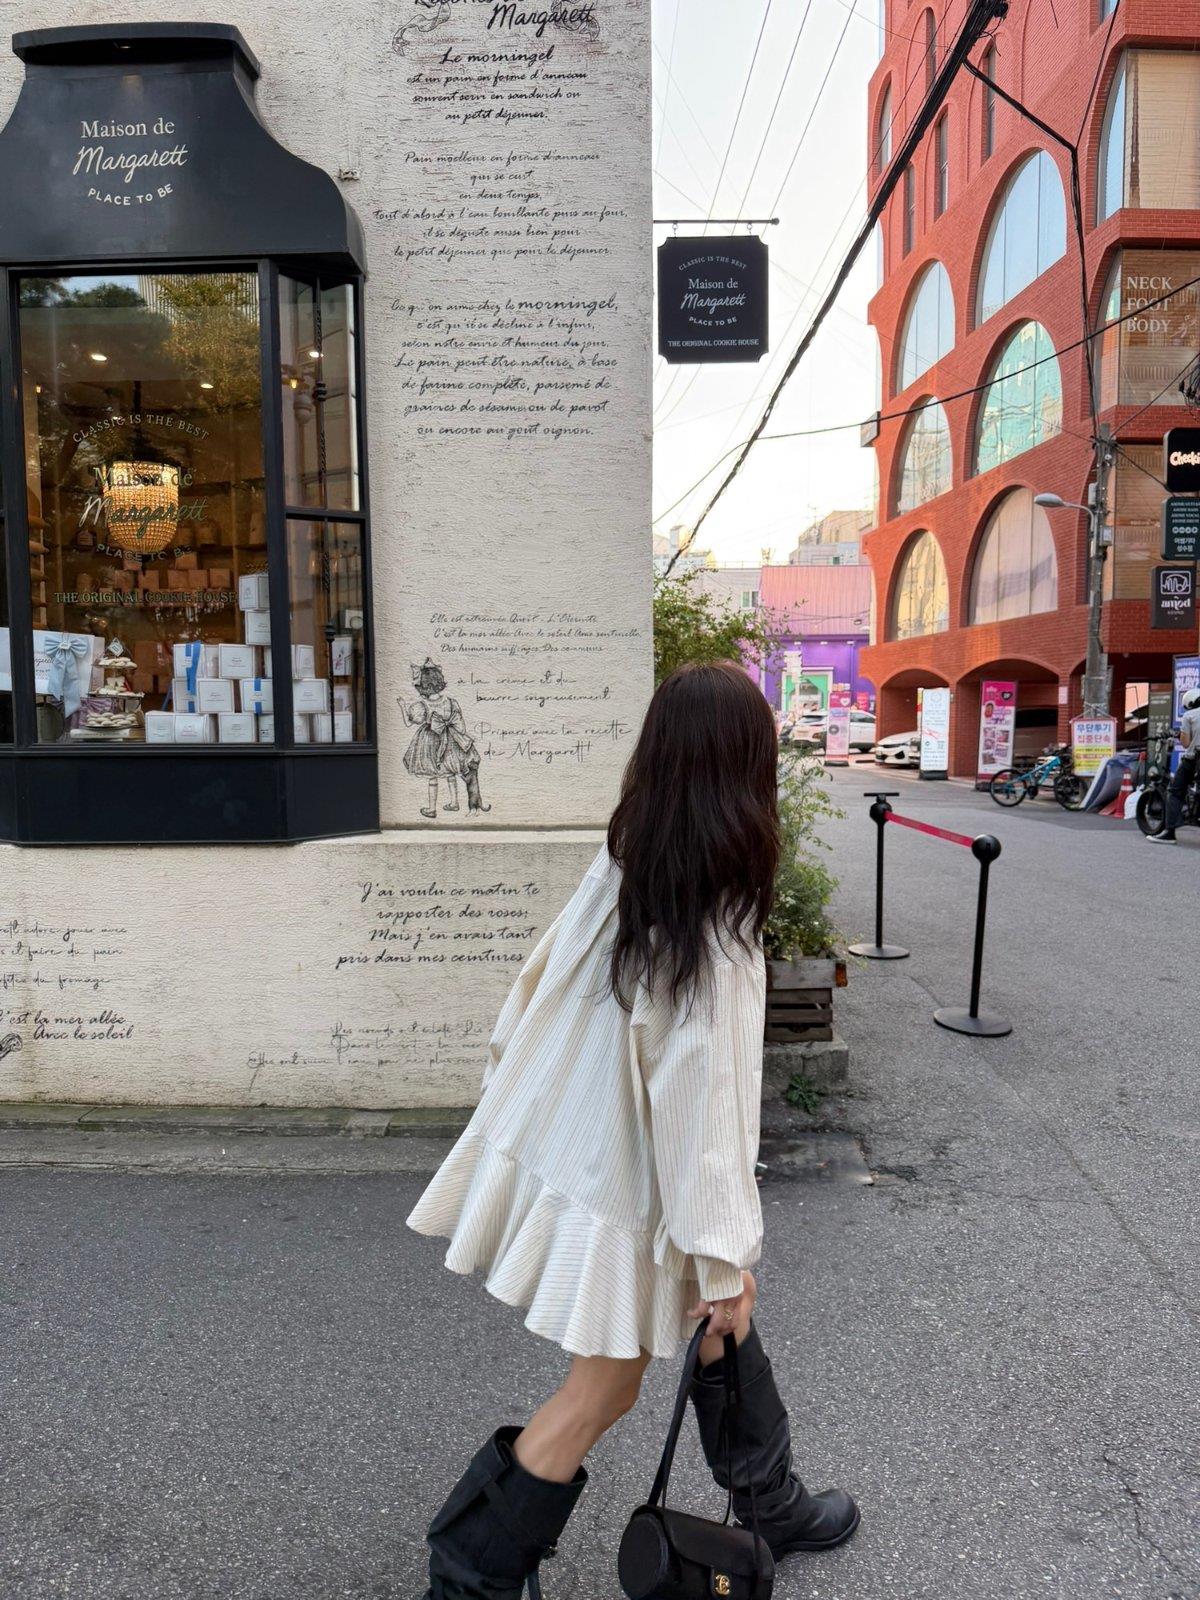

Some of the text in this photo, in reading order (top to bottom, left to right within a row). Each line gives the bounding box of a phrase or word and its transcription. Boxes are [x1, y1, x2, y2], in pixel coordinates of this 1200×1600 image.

[487, 4, 594, 37] Margarett
[439, 45, 555, 66] Le morningel
[493, 70, 526, 87] forme
[413, 91, 459, 102] souvent
[508, 88, 562, 99] sandwich
[463, 109, 494, 124] petit
[81, 118, 175, 138] Maison de
[73, 144, 188, 183] Margarett
[405, 151, 432, 163] Pain
[88, 183, 173, 205] PLACE TO BE
[406, 246, 436, 261] petit
[679, 256, 706, 271] CLASSIC
[731, 259, 747, 269] BEST
[688, 278, 738, 289] Maison de
[1127, 276, 1173, 289] NECK
[680, 293, 746, 314] Margarett
[1127, 298, 1172, 311] FOOT
[689, 316, 712, 326] PLACE
[1127, 319, 1172, 332] BODY
[416, 360, 450, 372] pain
[419, 376, 464, 396] farine
[403, 401, 456, 417] graines
[460, 399, 476, 412] de
[550, 399, 565, 412] de
[568, 400, 610, 417] pavot
[72, 413, 209, 443] CLASSIC IS THE BEST
[438, 426, 482, 435] encore
[93, 466, 193, 487] Maison de
[78, 495, 208, 539] Margarett
[97, 544, 143, 562] PLACE
[54, 592, 78, 603] THE
[81, 592, 139, 603] ORIGINAL
[1077, 723, 1111, 733] 무단투기
[361, 882, 540, 902] J'ai voulu ce matin te
[376, 904, 482, 925] rapporter des
[369, 926, 538, 949] Mais j'en avais tant
[335, 949, 526, 969] pris dans mes ceintures
[34, 1010, 49, 1024] la
[55, 1016, 84, 1024] mer
[89, 1009, 127, 1024] allée
[33, 1024, 135, 1040] Avec le soleil
